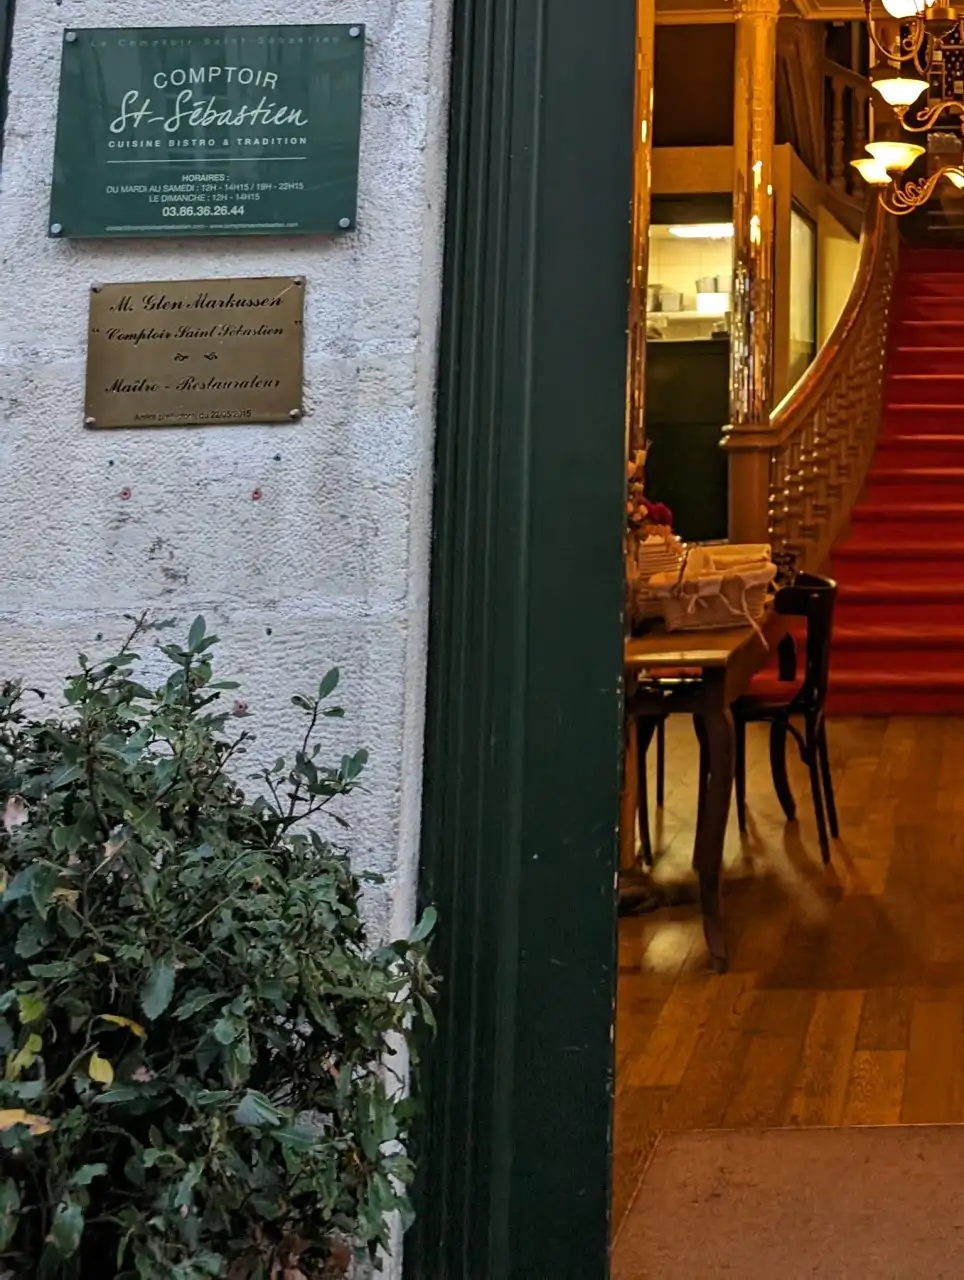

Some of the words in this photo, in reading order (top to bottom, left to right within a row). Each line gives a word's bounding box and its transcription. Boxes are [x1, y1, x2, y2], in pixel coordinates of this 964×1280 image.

[153, 66, 278, 90] COMPTOIR
[109, 89, 308, 133] St-Sébastien
[108, 140, 161, 148] CUISINE
[168, 138, 215, 147] BISTRO
[236, 136, 307, 145] TRADITION
[182, 173, 225, 182] HORAIRES
[106, 185, 119, 194] DU
[120, 185, 148, 193] MARDI
[148, 184, 161, 192] AU
[162, 184, 195, 192] SAMEDI
[148, 195, 159, 203] LE
[161, 193, 206, 202] DIMANCHE
[109, 295, 134, 312] M.
[142, 294, 184, 311] Glen
[186, 292, 284, 309] Markussen
[106, 327, 172, 345] Comptoir
[174, 325, 216, 339] Saint
[175, 375, 281, 391] Restaurateur
